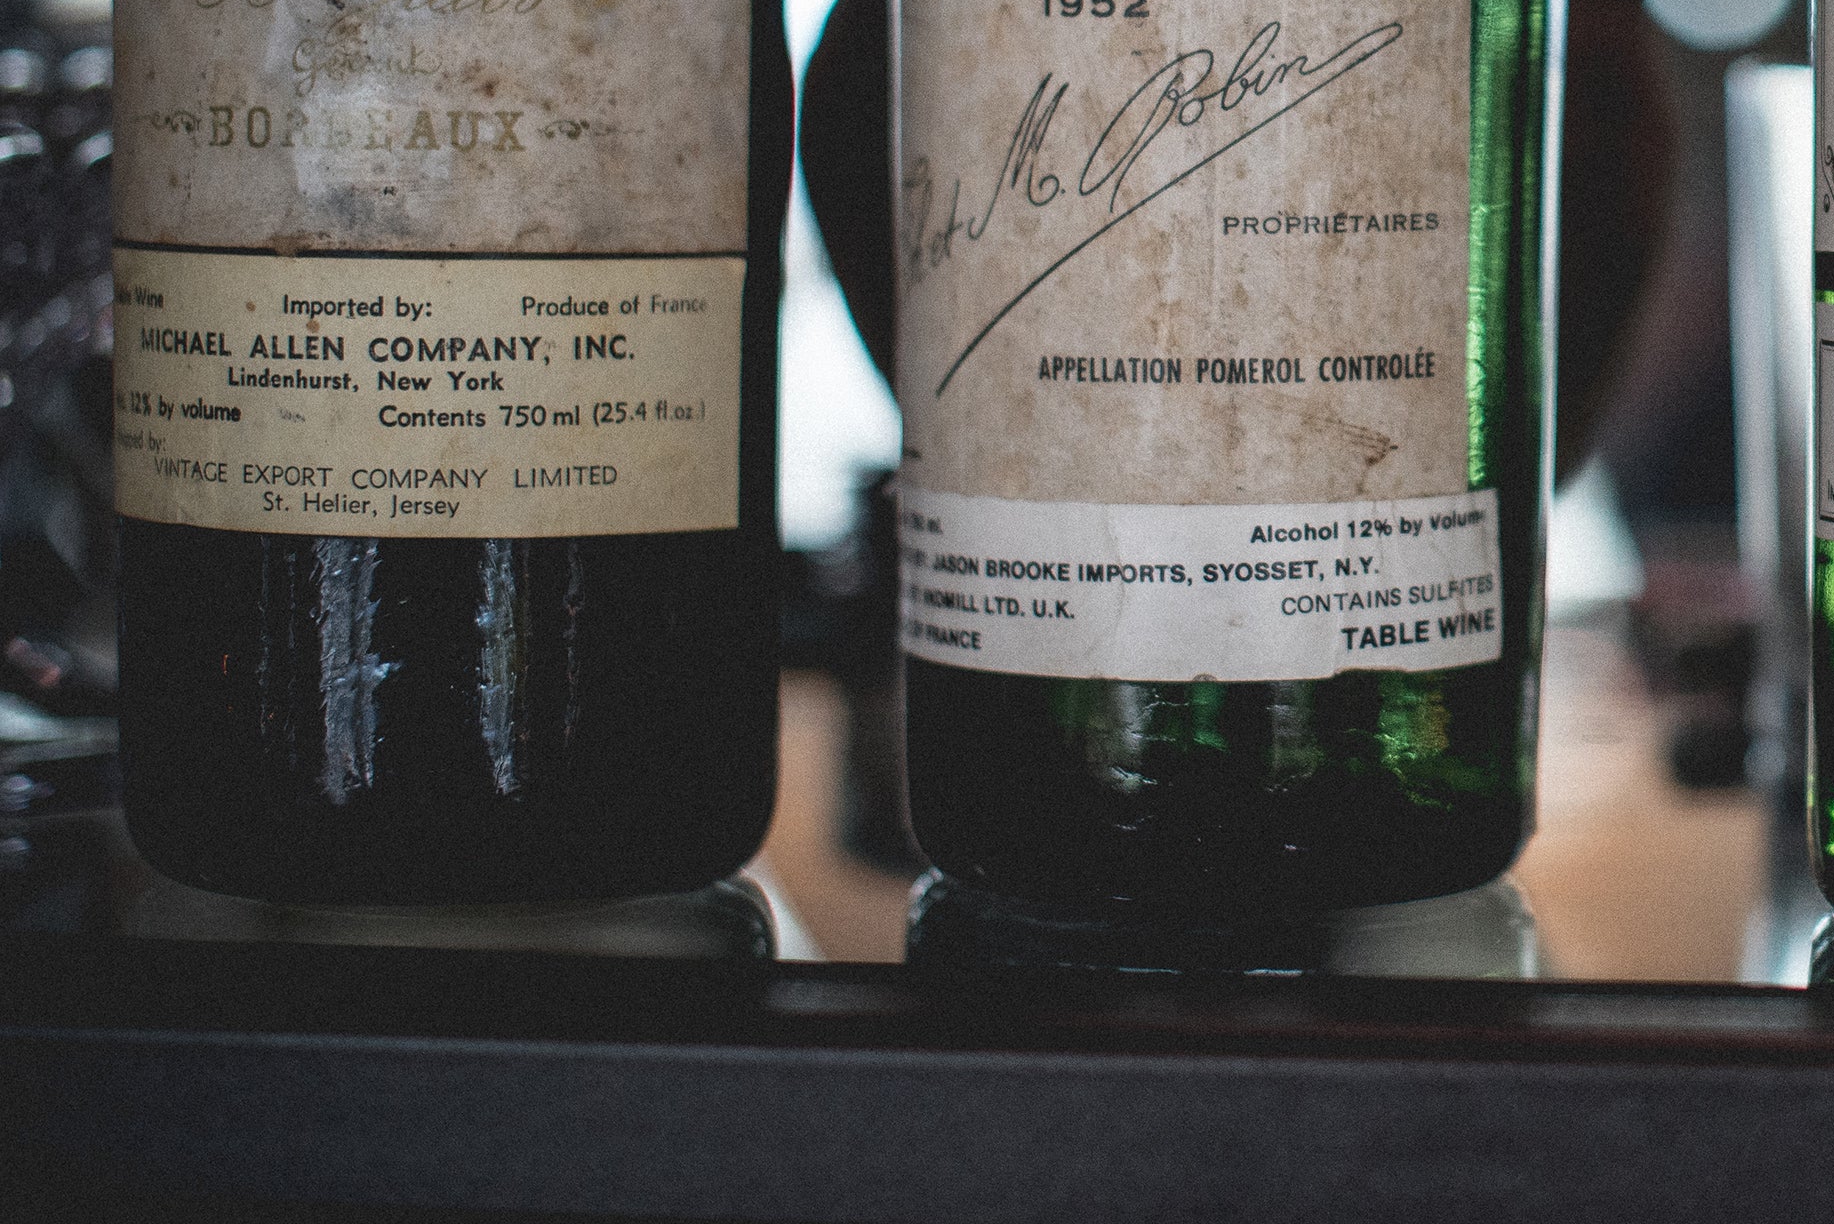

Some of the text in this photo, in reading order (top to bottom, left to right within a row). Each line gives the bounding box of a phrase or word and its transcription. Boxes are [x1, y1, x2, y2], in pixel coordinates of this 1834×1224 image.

[1221, 210, 1440, 237] PROPRIÉTAIRES
[283, 284, 433, 322] Imported by:
[521, 294, 610, 317] Produce
[619, 294, 641, 316] of
[140, 326, 635, 367] MICHAEL ALLEN COMPANY, INC.
[1038, 346, 1436, 383] APPELLATION POMEROL CONTROLÉE
[228, 366, 505, 394] Lindenhurst, New York
[158, 395, 175, 422] by
[181, 397, 242, 423] volume
[378, 404, 486, 428] Contents
[499, 404, 547, 427] 750
[553, 405, 581, 426] ml
[592, 402, 648, 426] (25.4
[154, 456, 618, 490] VINTAGE EXPORT COMPANY LIMITED
[263, 490, 461, 519] St. Helier, Jersey
[1250, 521, 1340, 544] Alcohol
[1346, 518, 1393, 539] 12%
[1399, 516, 1423, 538] by
[932, 550, 979, 576] JASON
[983, 559, 1071, 582] BROOKE
[1078, 562, 1193, 587] IMPORTS,
[1202, 560, 1326, 583] SYOSSET,
[1334, 556, 1380, 577] N.Y.
[984, 595, 1026, 618] LTD.
[1033, 598, 1075, 620] U.K.
[1281, 574, 1495, 616] CONTAINS SULFITES
[922, 622, 982, 651] FRANCE
[1341, 607, 1497, 651] TABLE WINE
